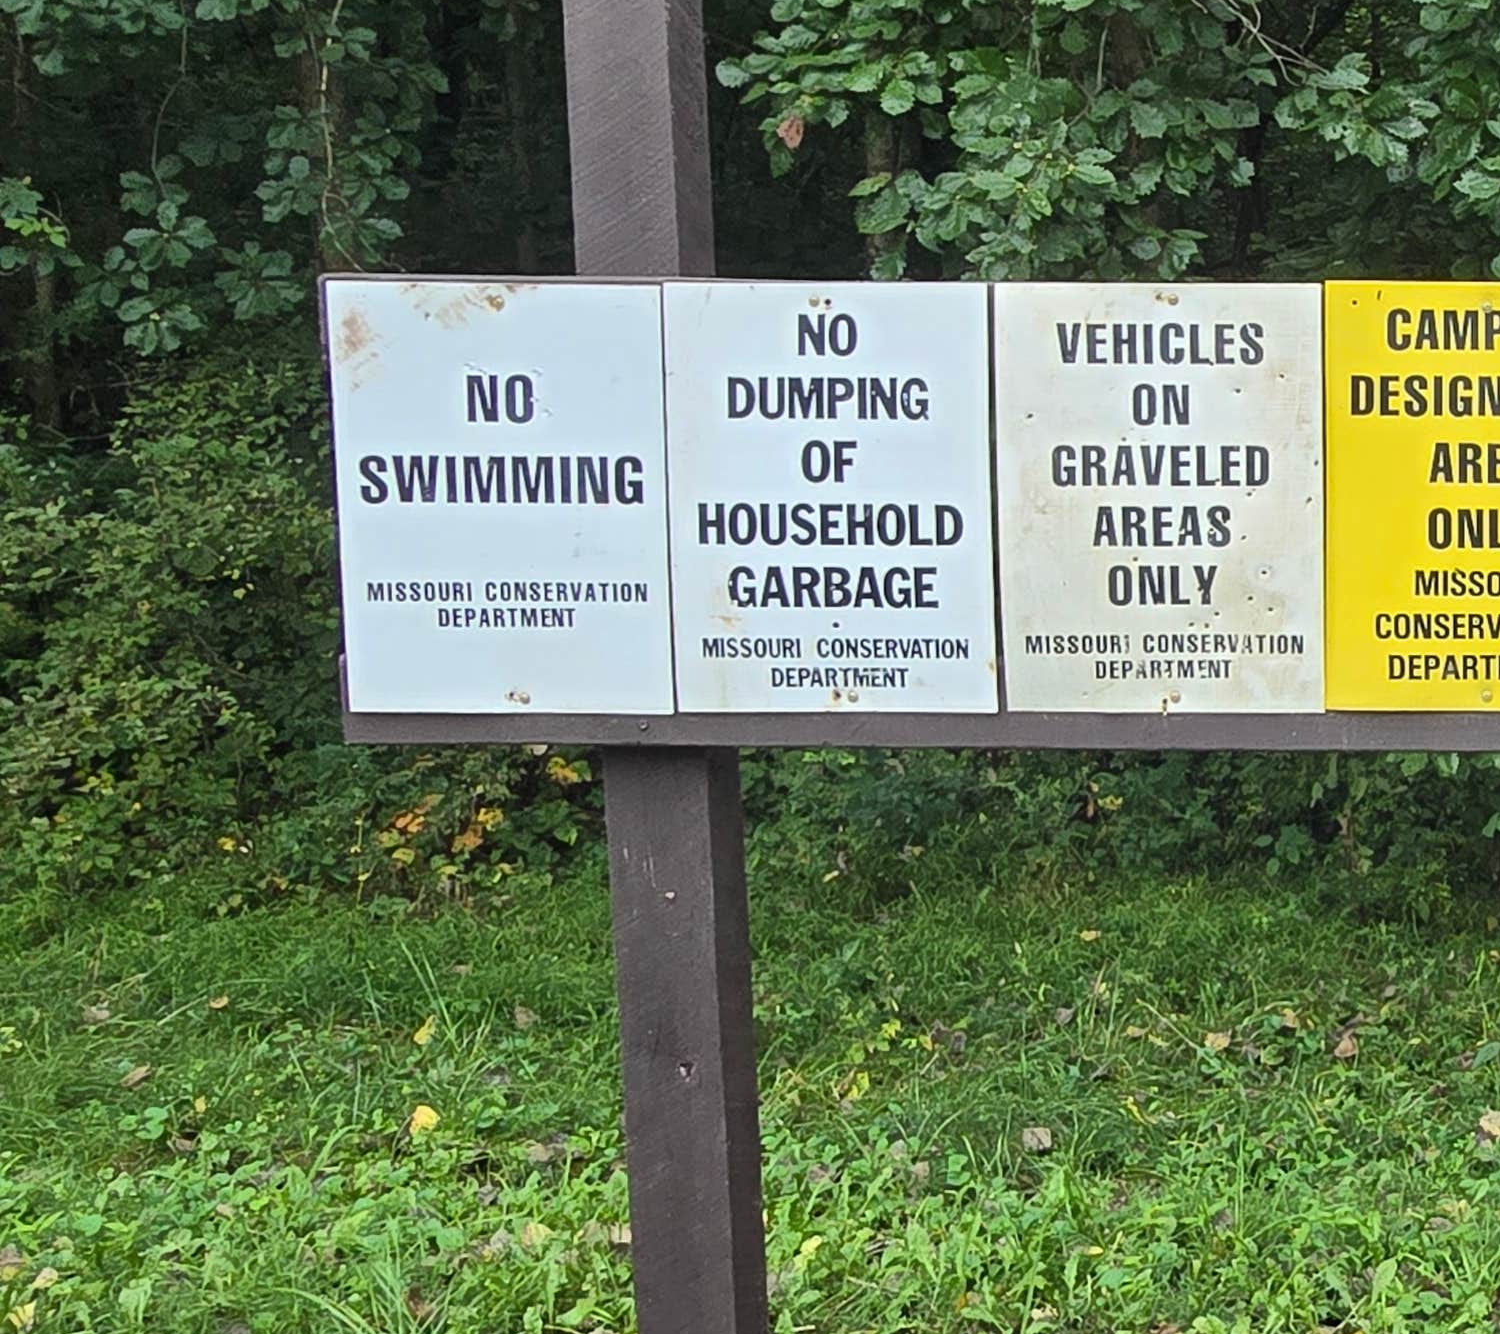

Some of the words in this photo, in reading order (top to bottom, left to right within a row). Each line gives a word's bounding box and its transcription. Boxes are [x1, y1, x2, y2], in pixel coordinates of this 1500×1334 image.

[797, 314, 857, 357] NO
[1056, 322, 1265, 365] VEHICLES
[466, 374, 534, 423] NO
[727, 377, 929, 420] DUMPING
[1132, 384, 1190, 426] ON
[359, 455, 644, 505] SWIMMING
[801, 440, 857, 483] OF
[1052, 445, 1270, 487] GRAVELED
[698, 502, 964, 546] HOUSEHOLD
[1093, 506, 1232, 548] AREAS
[366, 582, 473, 602] MISSOURI
[484, 582, 648, 603] CONSERVATION
[728, 566, 939, 608] GARBAGE
[1108, 565, 1217, 606] ONLY
[437, 609, 576, 628] DEPARTMENT
[702, 639, 801, 658] MISSOURI
[816, 639, 969, 659] CONSERVATION
[1025, 635, 1130, 655] MISSOURI
[1143, 634, 1305, 655] CONSERVATION
[771, 668, 909, 688] DEPARTMENT
[1095, 660, 1232, 679] DEPARTMENT
